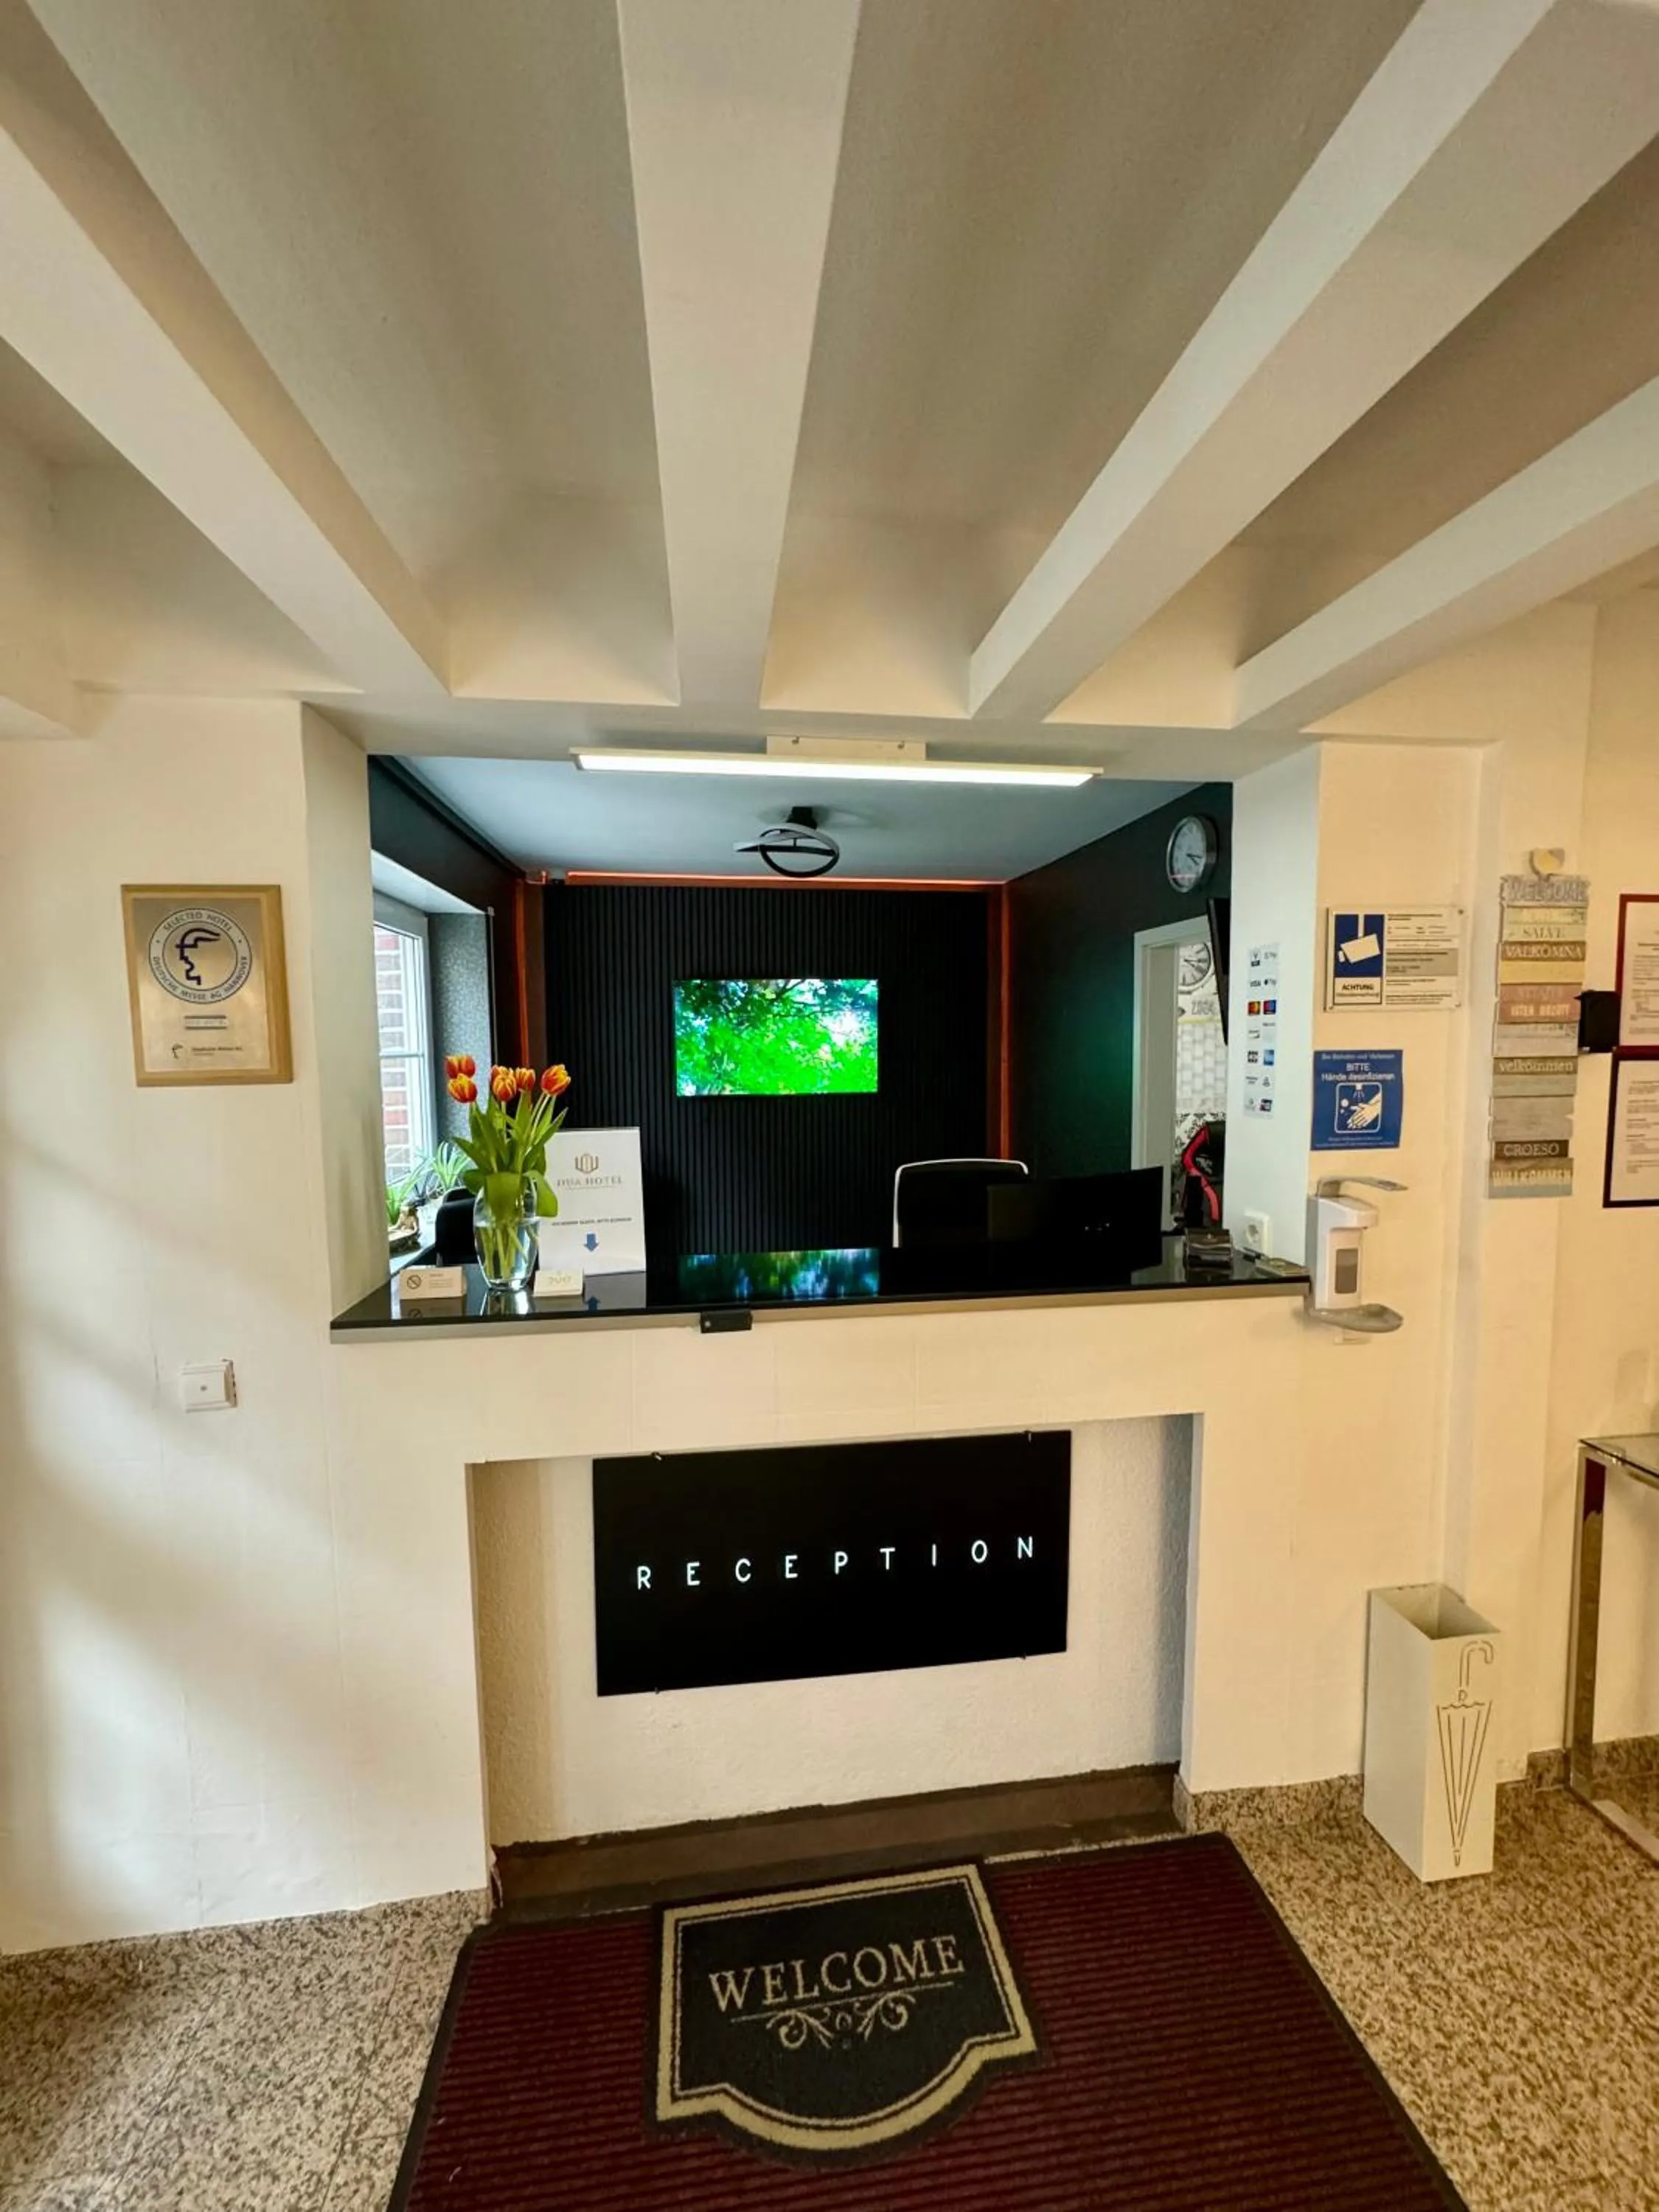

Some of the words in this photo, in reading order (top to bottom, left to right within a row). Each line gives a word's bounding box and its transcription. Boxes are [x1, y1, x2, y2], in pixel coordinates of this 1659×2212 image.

[163, 911, 203, 932] SELECTED
[206, 914, 233, 931] HOTEL
[1346, 1062, 1371, 1071] BITTE
[1320, 1073, 1347, 1081] Hände
[1503, 1144, 1559, 1157] CROESO
[585, 1175, 622, 1186] HOTEL
[636, 1534, 1035, 1591] RECEPTION
[709, 1933, 966, 2014] WELCOME
